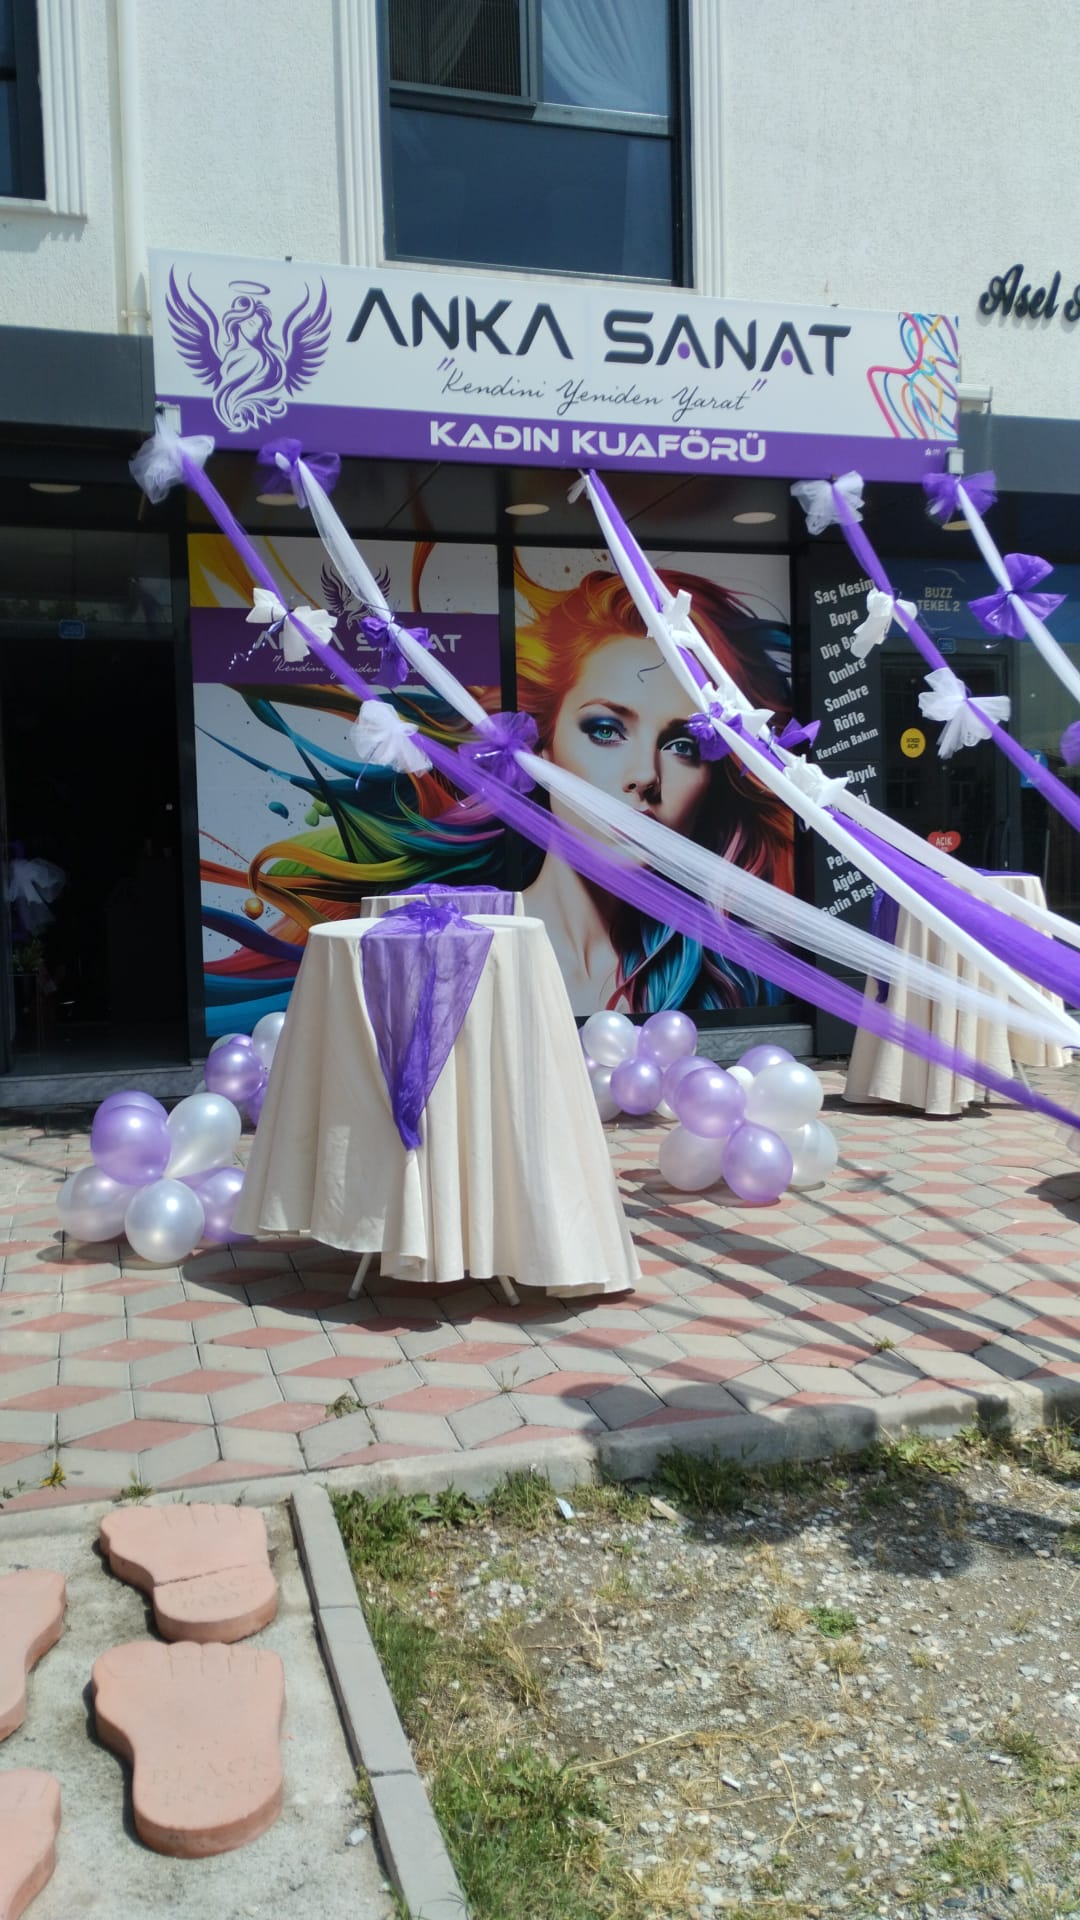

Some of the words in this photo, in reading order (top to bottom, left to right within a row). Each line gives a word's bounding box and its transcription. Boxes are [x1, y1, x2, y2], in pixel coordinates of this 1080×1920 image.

[978, 263, 1062, 320] Asel
[346, 287, 574, 360] ANKA
[603, 309, 851, 376] SANAT
[556, 378, 663, 416] Yeniden
[430, 420, 560, 453] KADIN
[572, 428, 766, 463] KUAFÖRÜ
[814, 589, 838, 605] Saç
[838, 578, 876, 598] Kesim
[924, 586, 953, 599] BUZZ
[829, 609, 859, 627] Boya
[917, 599, 951, 612] TEKEL
[952, 600, 961, 612] 2
[819, 643, 841, 660] Dip
[828, 658, 867, 684] Ombre
[823, 684, 869, 712] Sombre
[833, 711, 866, 732] Röfle
[815, 740, 851, 760] Keratin
[849, 728, 879, 746] Bakım
[832, 870, 862, 893] Ağda
